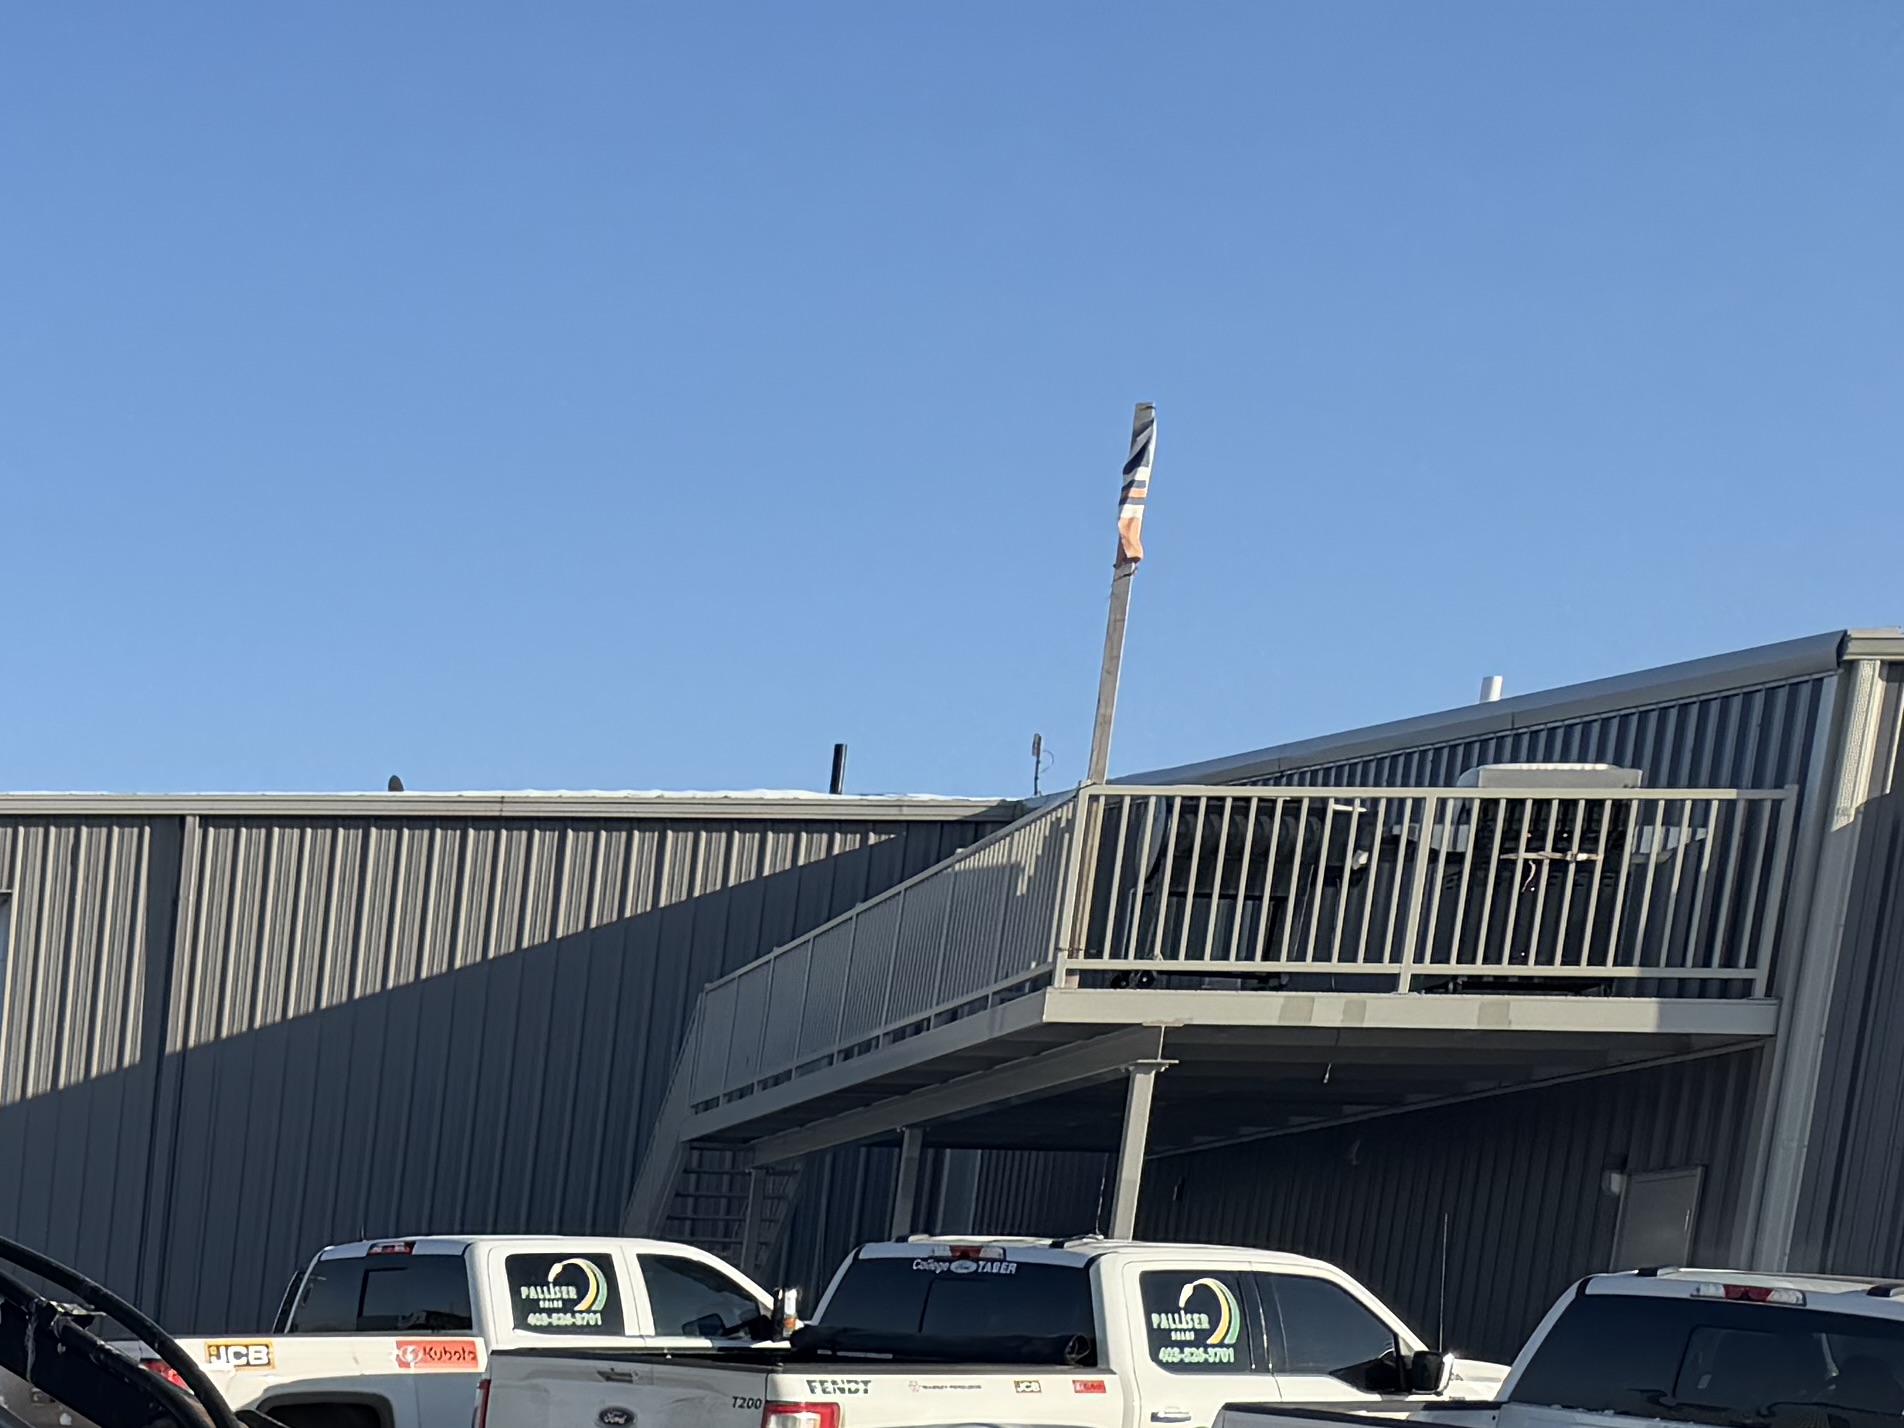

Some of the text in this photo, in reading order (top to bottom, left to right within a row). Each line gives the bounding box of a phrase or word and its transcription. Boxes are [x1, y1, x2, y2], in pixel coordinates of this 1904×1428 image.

[520, 1283, 577, 1299] PALLISER
[1151, 1310, 1210, 1329] PALLISER
[209, 1345, 269, 1365] JCB
[805, 1379, 872, 1395] FENDT
[731, 1396, 762, 1410] T200
